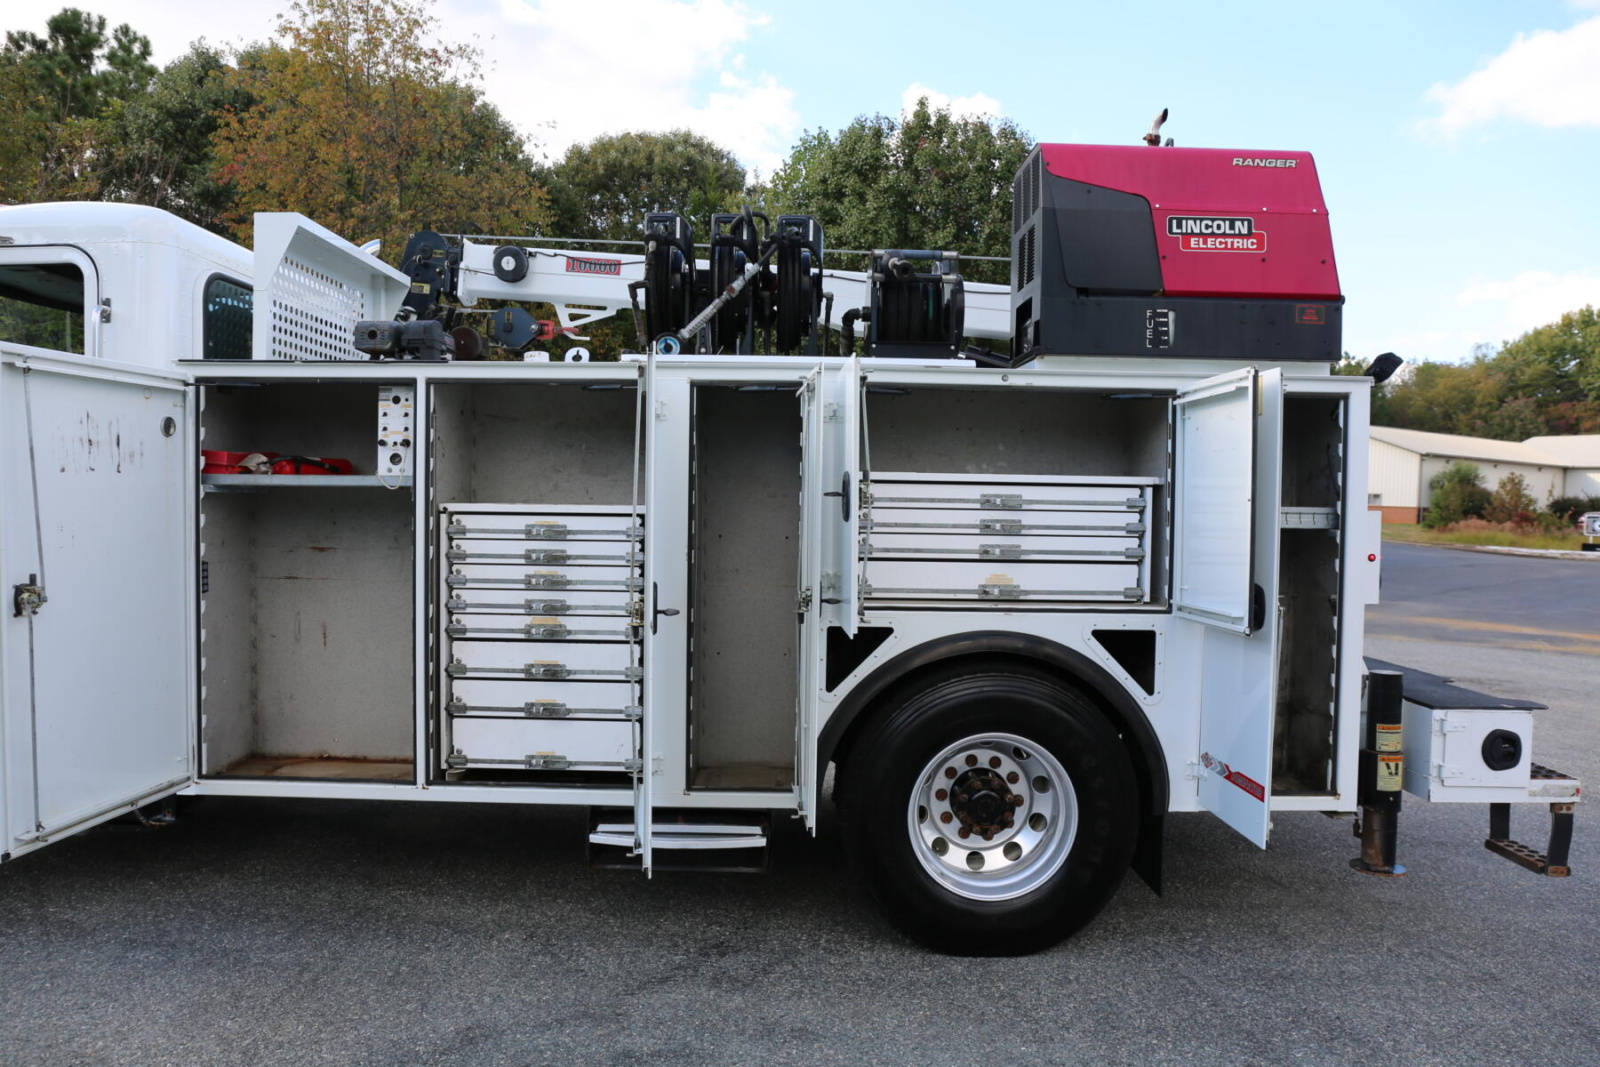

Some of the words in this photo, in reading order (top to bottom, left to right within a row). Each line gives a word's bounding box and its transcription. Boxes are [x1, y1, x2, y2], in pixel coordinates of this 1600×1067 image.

[1232, 157, 1296, 168] RANGER
[1172, 219, 1248, 234] LINCOLN
[1190, 237, 1257, 249] ELECTRIC
[1146, 309, 1154, 348] FUEL
